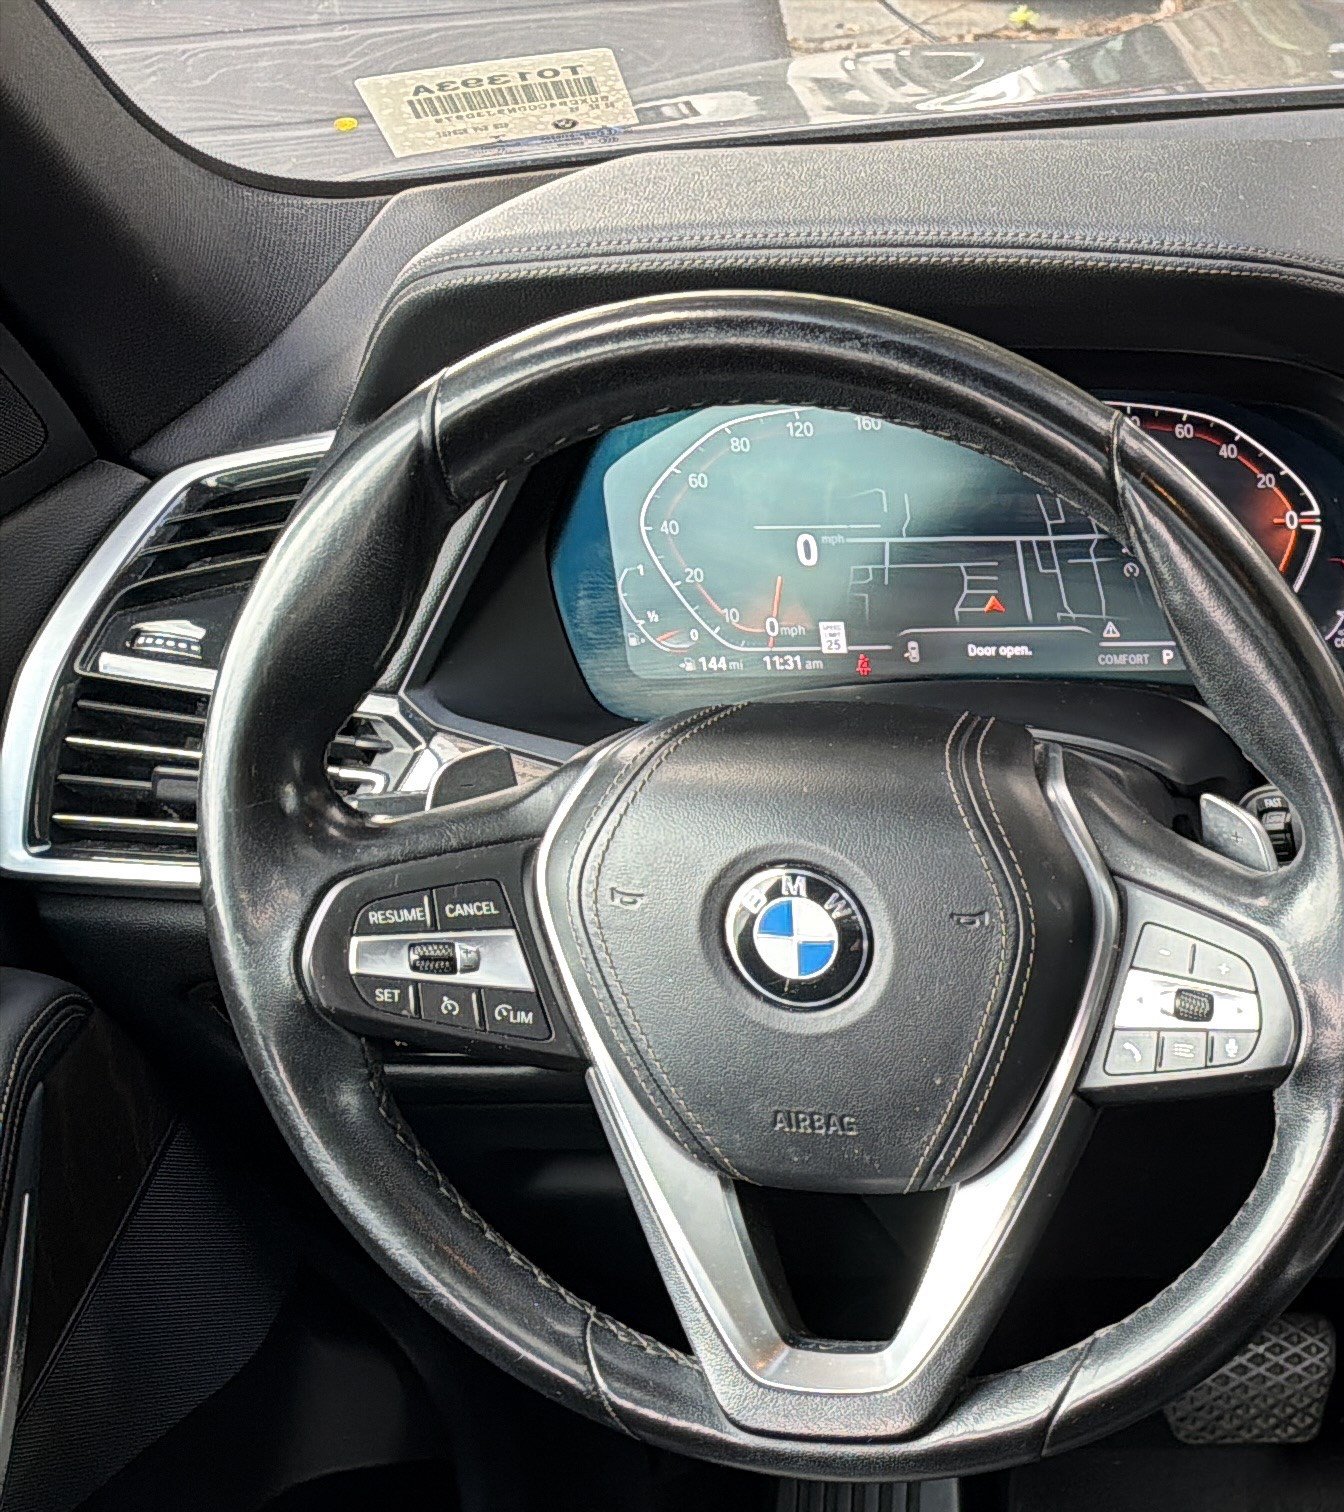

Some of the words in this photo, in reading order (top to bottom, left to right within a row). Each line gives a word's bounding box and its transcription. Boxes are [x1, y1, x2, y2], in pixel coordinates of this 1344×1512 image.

[786, 422, 814, 438] 120
[855, 416, 882, 432] 160
[1174, 423, 1195, 439] 60
[730, 437, 750, 453] 80
[1219, 444, 1238, 459] 40
[688, 473, 708, 489] 60
[1256, 473, 1276, 489] 20
[660, 520, 680, 536] 40
[1285, 511, 1298, 529] 0
[796, 533, 819, 567] 0
[821, 533, 845, 546] mph
[685, 568, 704, 583] 20
[723, 608, 740, 623] 10
[765, 617, 779, 637] 0
[780, 624, 806, 638] mph
[826, 639, 841, 651] 25
[967, 644, 998, 657] Door
[999, 645, 1033, 659] open.
[699, 656, 728, 672] 144
[729, 660, 744, 671] mi
[763, 655, 802, 672] 11:31
[806, 659, 824, 672] am
[1098, 653, 1150, 666] COMFORT
[1162, 649, 1174, 665] P
[741, 875, 851, 920] BMW
[368, 907, 425, 925] RESUME
[445, 901, 500, 918] CANCEL
[375, 988, 401, 1003] SET
[510, 1011, 533, 1025] LIM
[773, 1110, 859, 1136] AIRBAG
